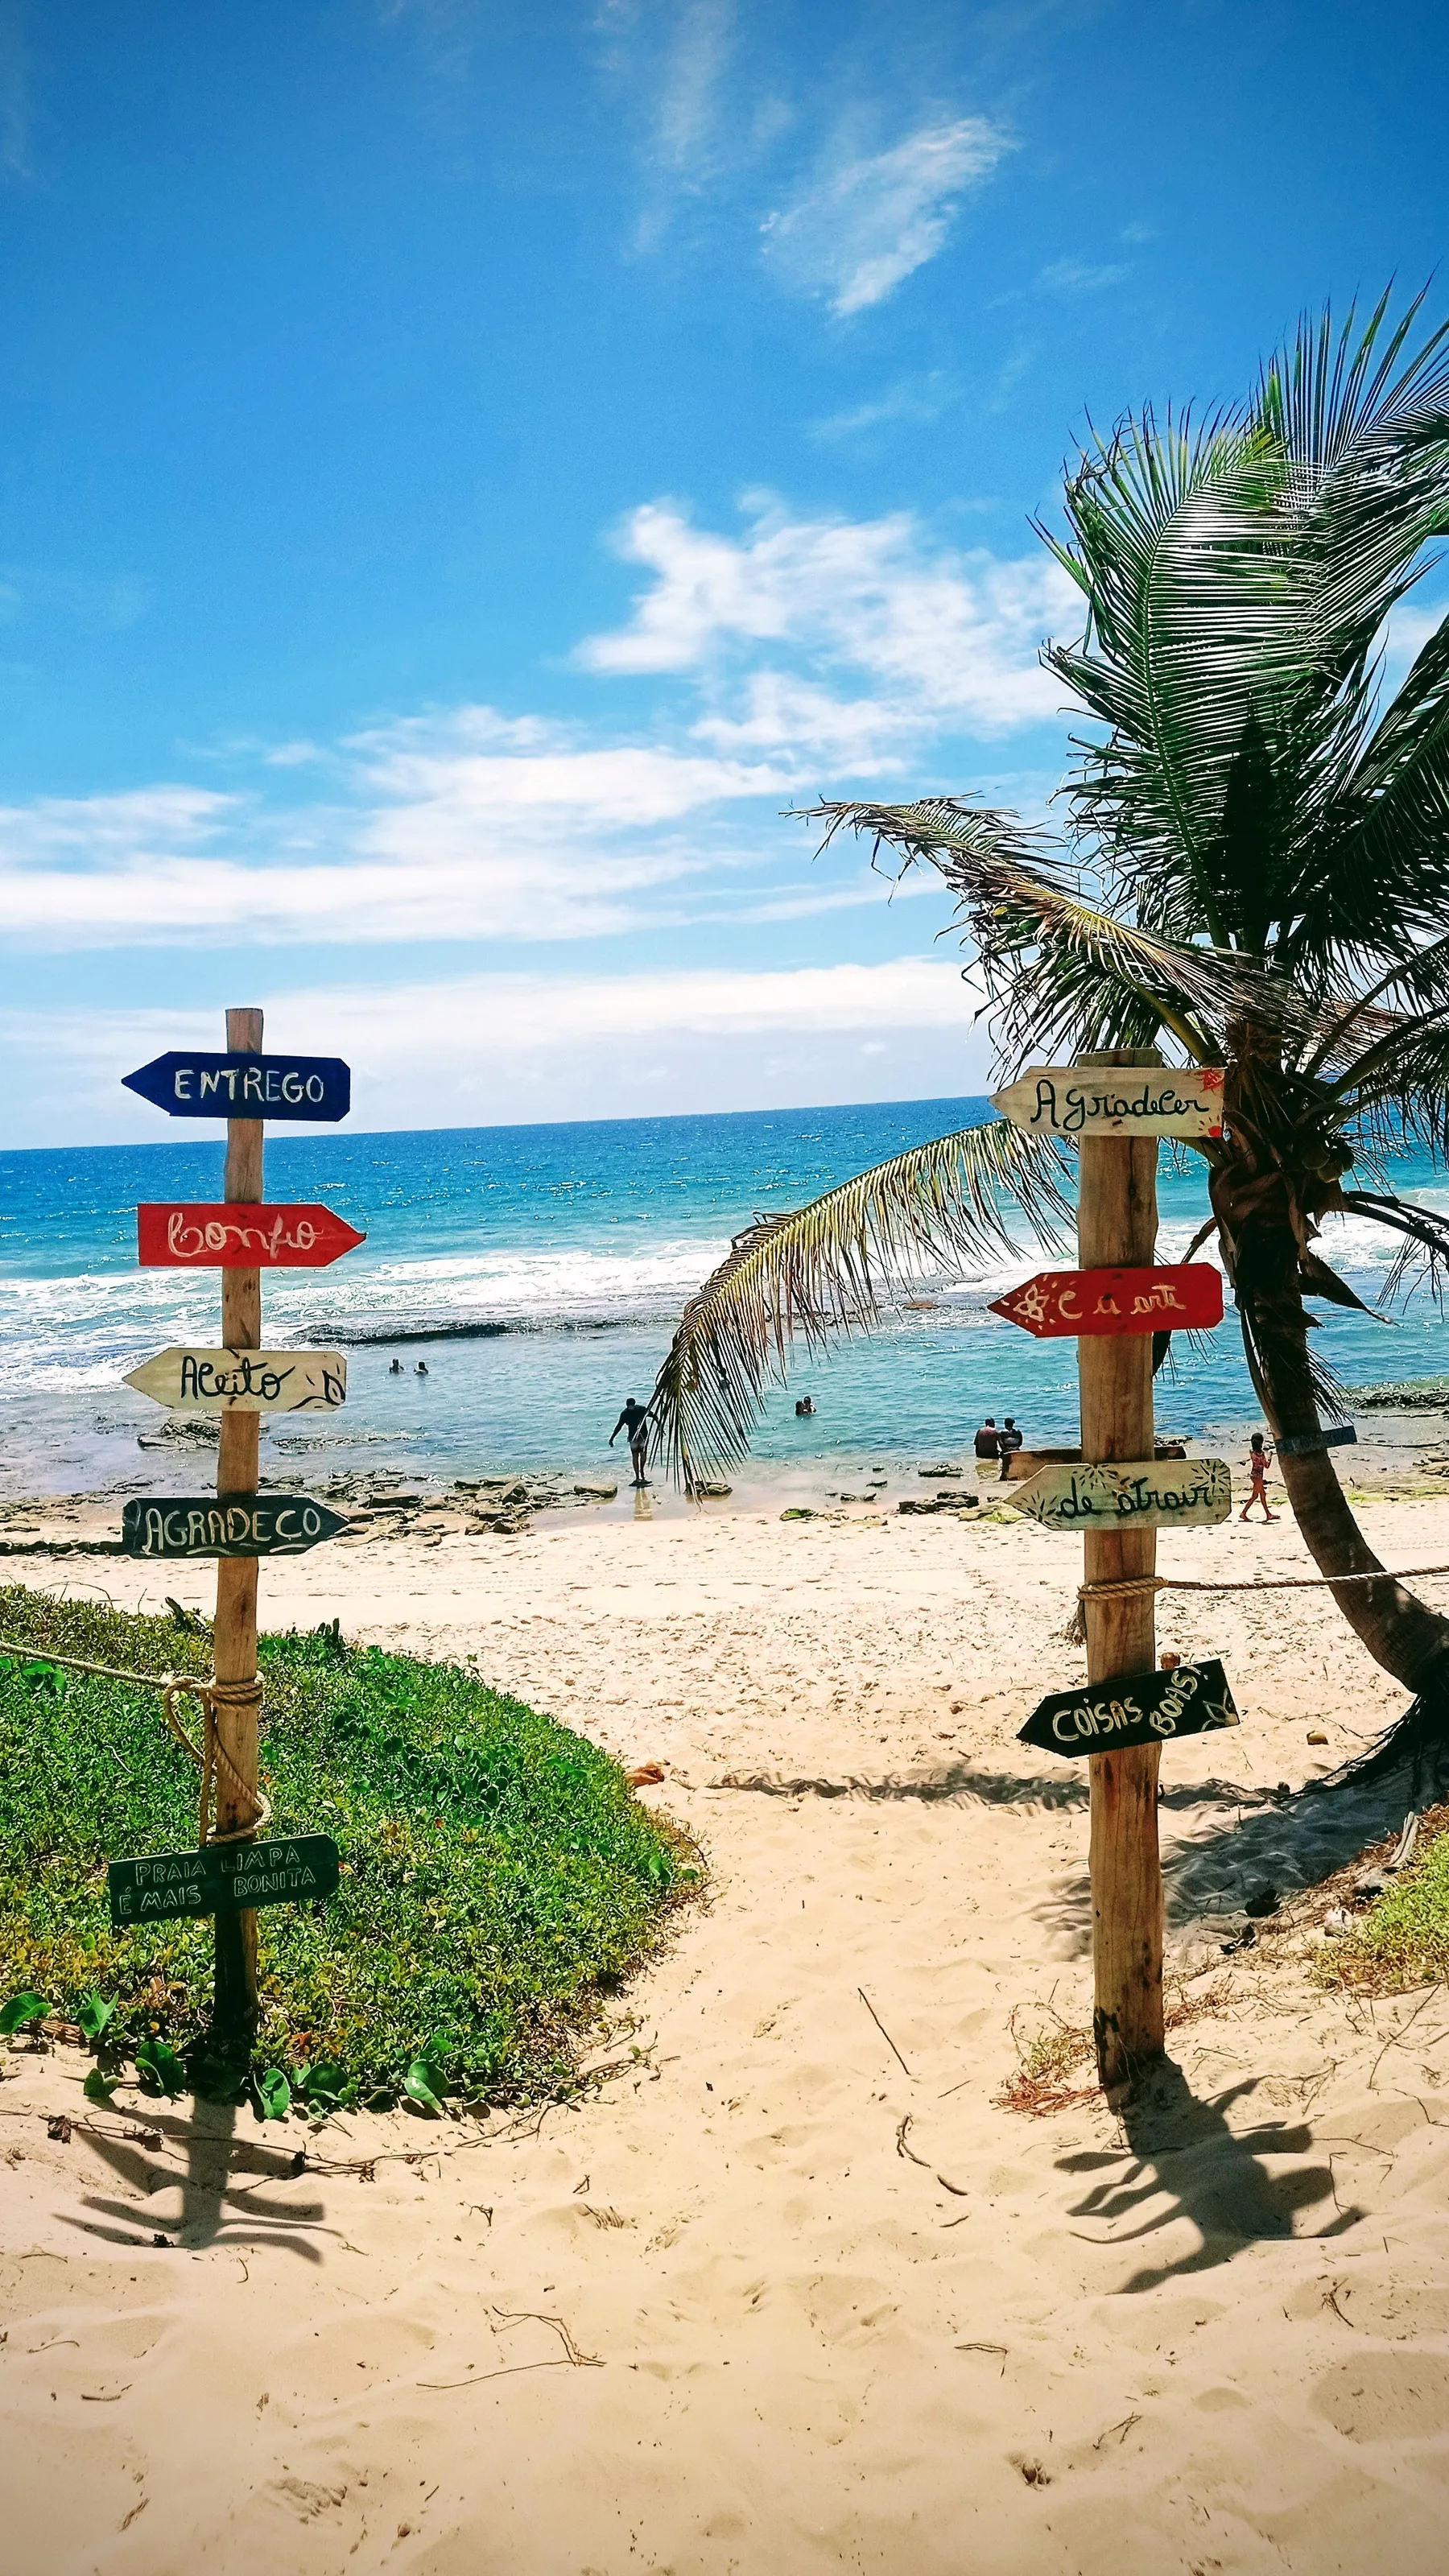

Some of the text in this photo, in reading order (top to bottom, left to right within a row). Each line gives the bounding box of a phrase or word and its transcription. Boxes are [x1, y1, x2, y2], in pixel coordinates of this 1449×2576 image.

[174, 1067, 324, 1103] ENTREGO
[1055, 1476, 1102, 1519] de
[135, 1845, 300, 1886] PRAIA LIMPA
[119, 1866, 316, 1914] É MAIS BONITA
